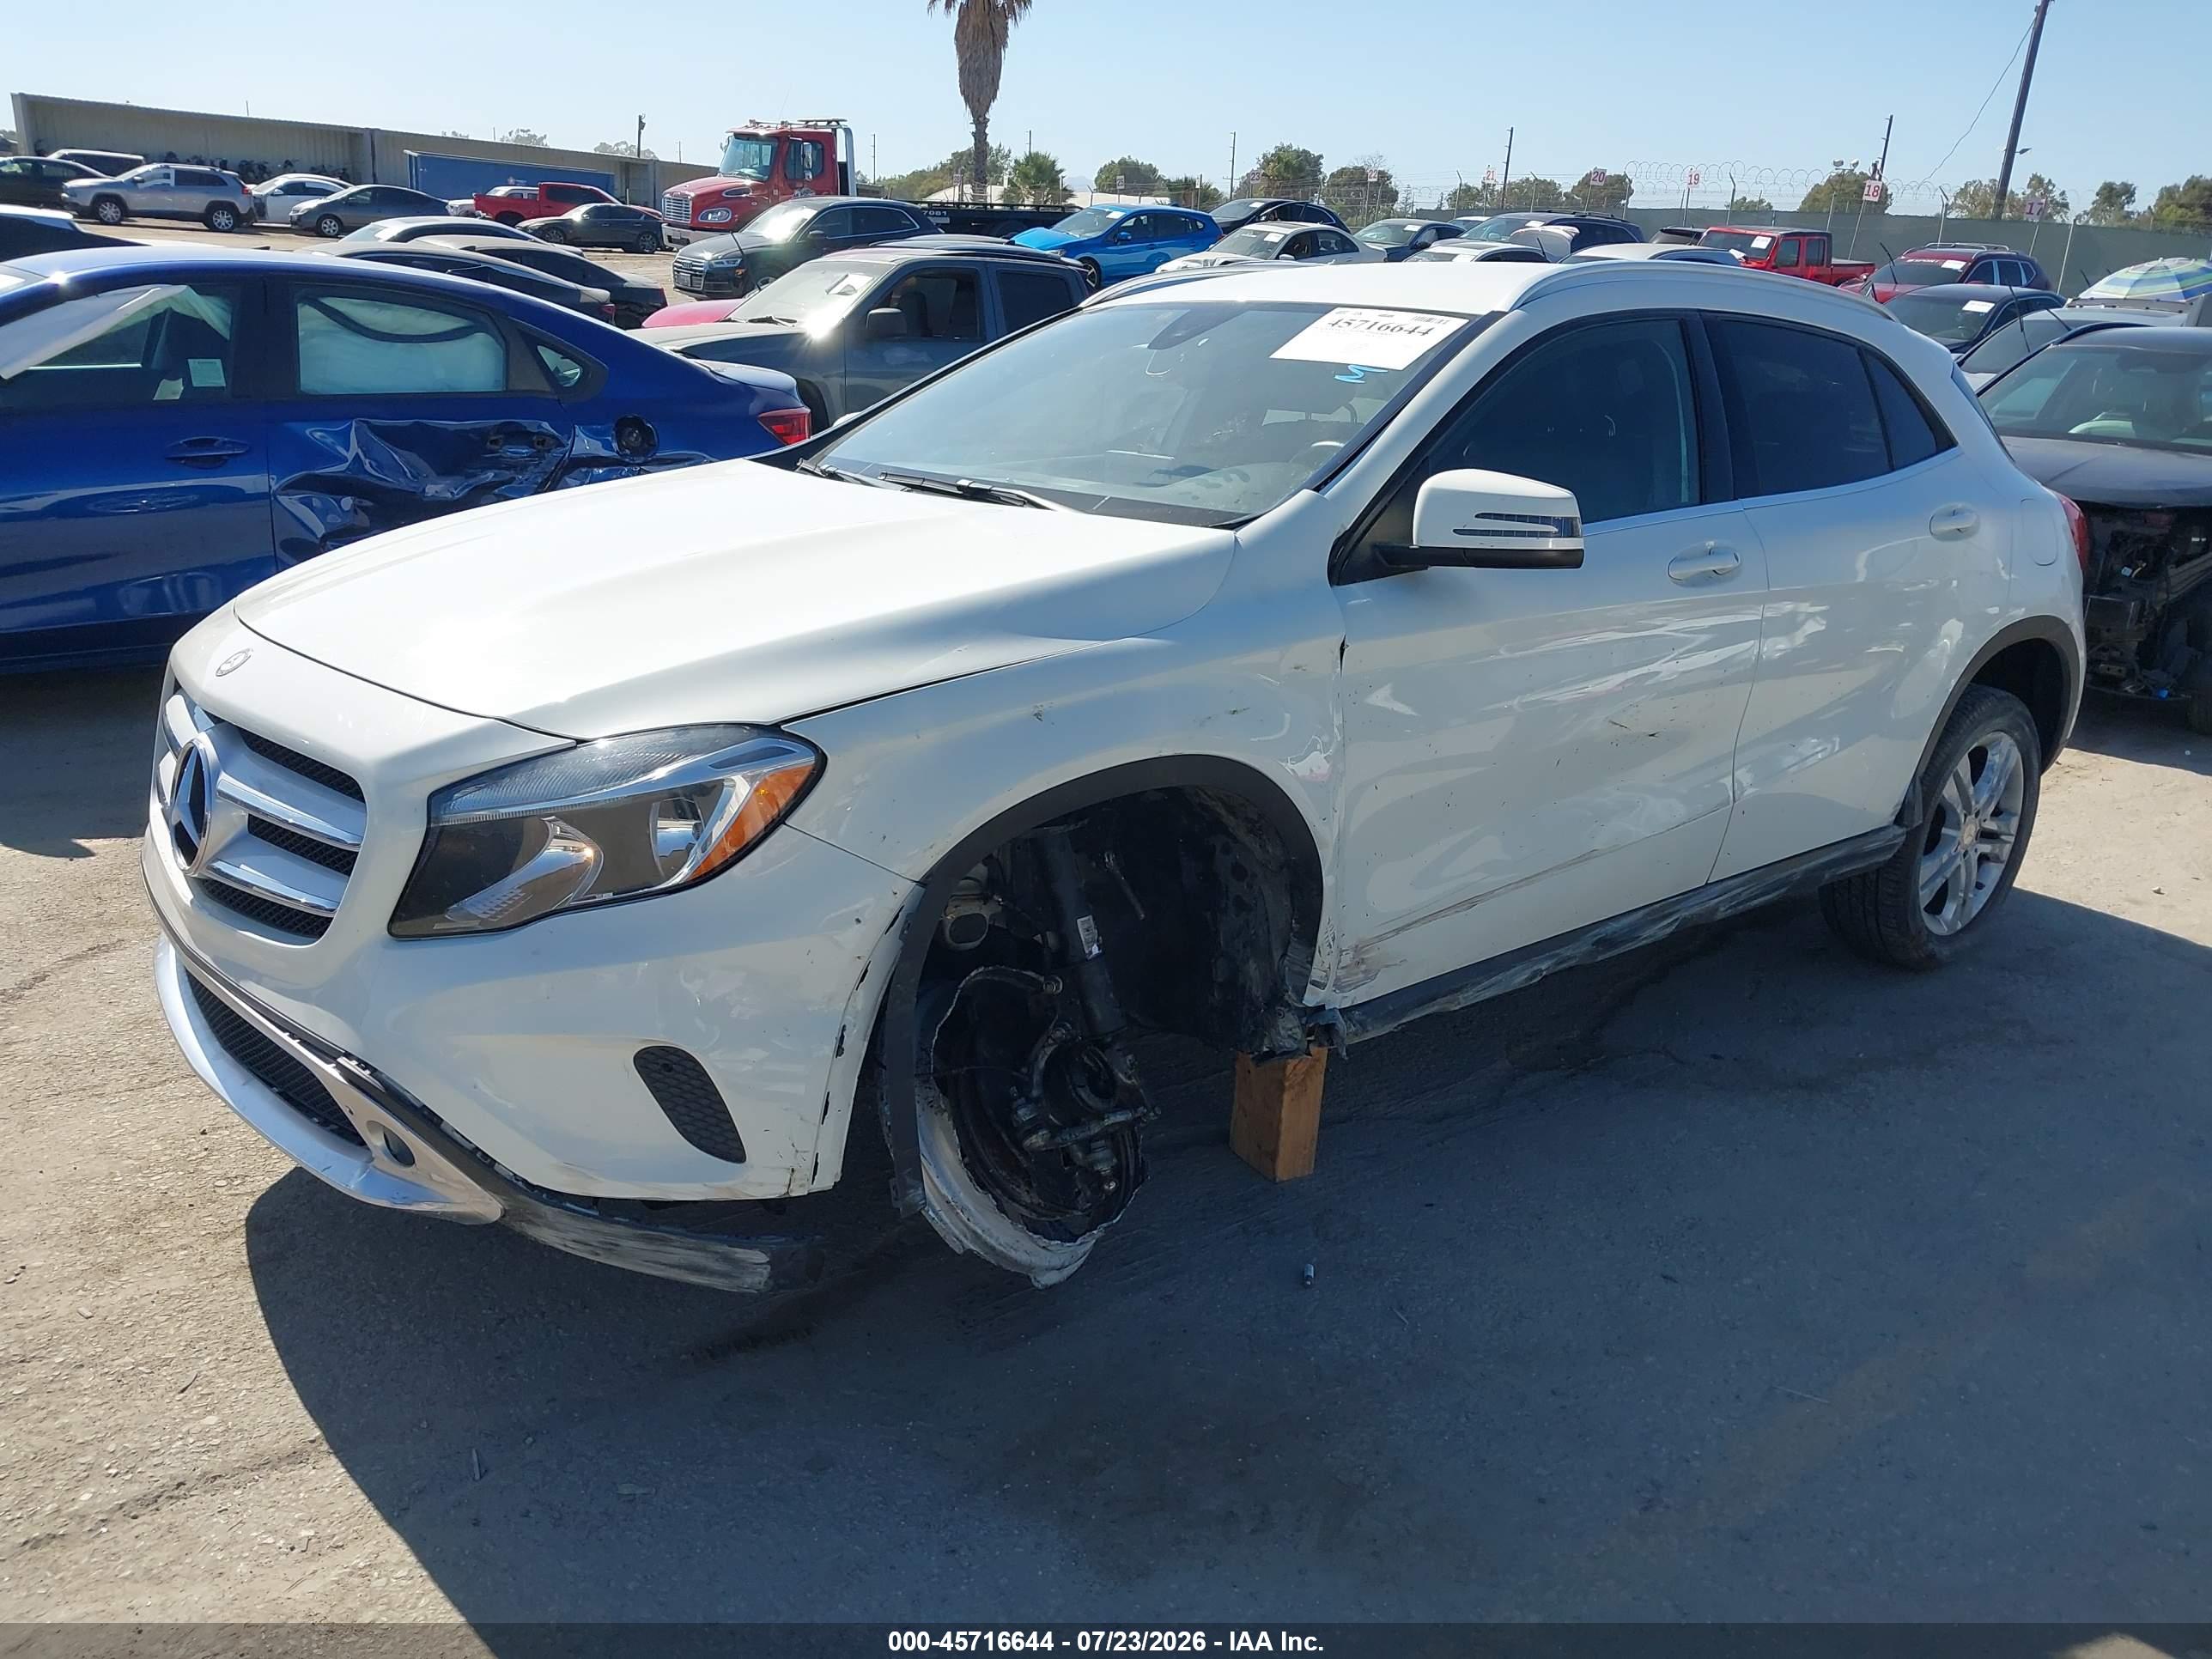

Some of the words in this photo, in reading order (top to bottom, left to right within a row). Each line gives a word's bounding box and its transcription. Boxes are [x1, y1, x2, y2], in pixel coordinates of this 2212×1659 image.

[1250, 172, 1261, 180] 23
[1368, 169, 1377, 179] 22
[1486, 170, 1495, 180] 21
[1591, 171, 1606, 183] 20
[1687, 173, 1700, 185] 19
[1864, 184, 1881, 198] 18
[2026, 202, 2045, 216] 17
[1327, 318, 1436, 336] 45716644
